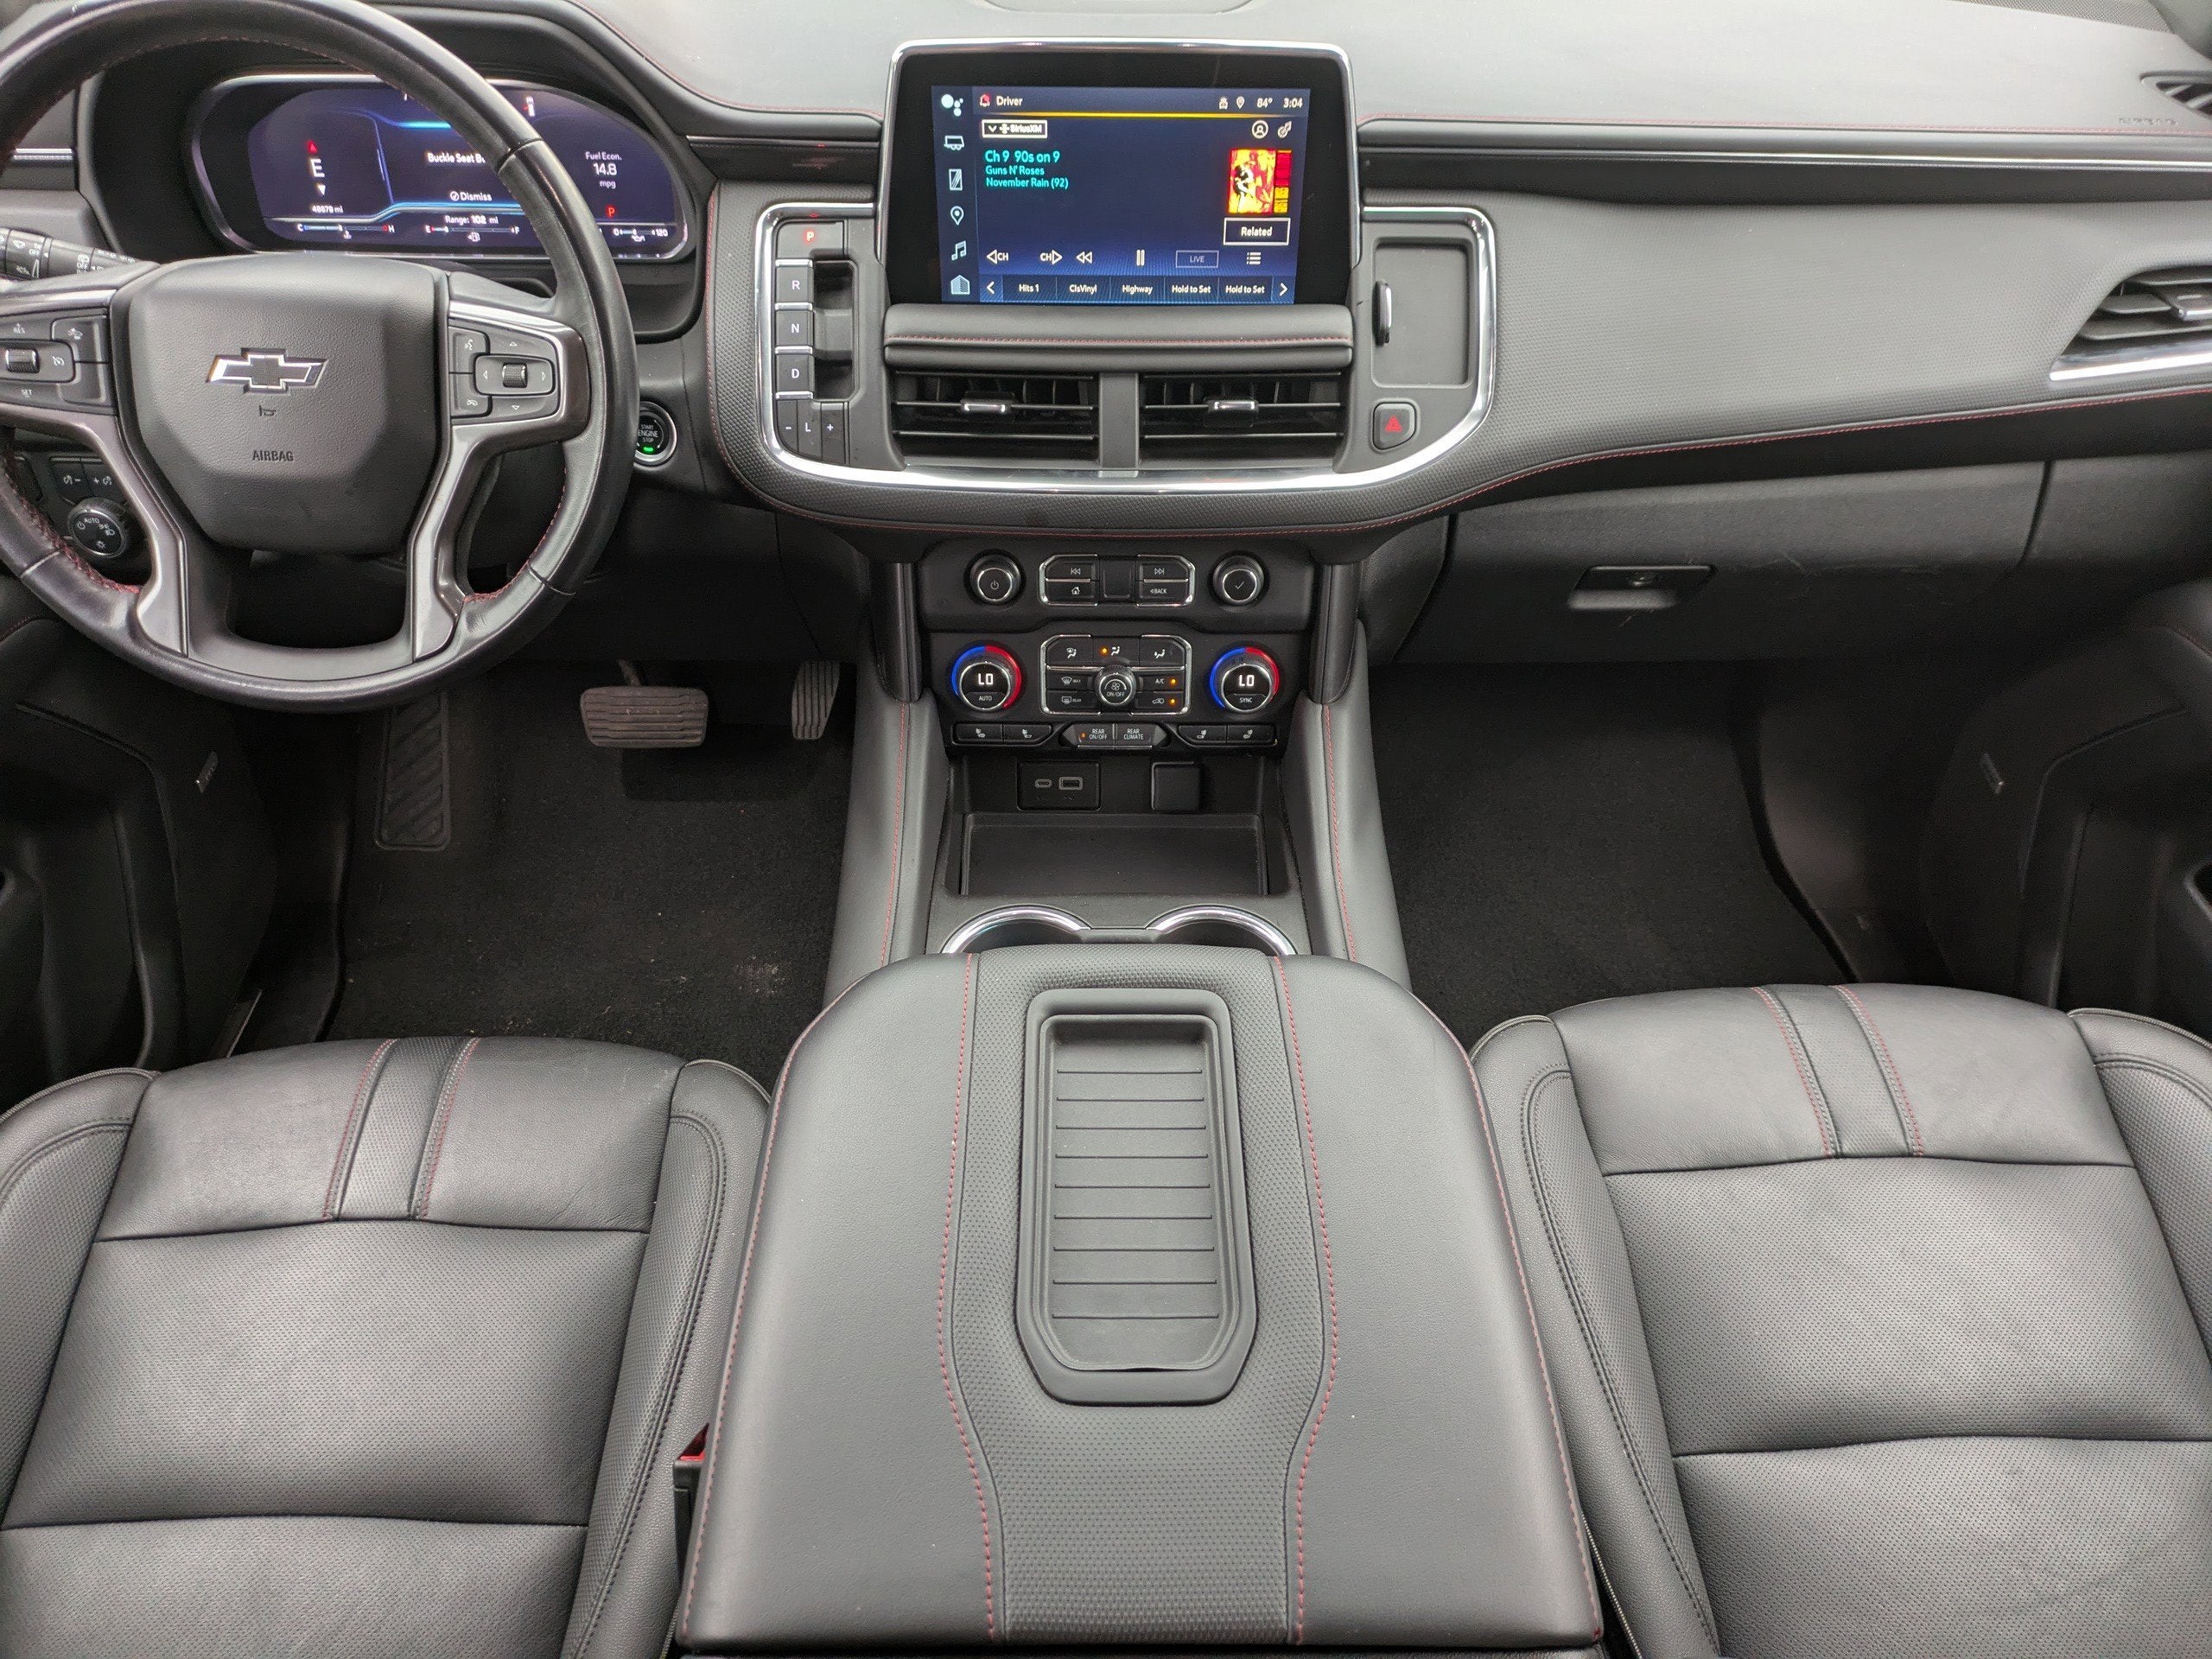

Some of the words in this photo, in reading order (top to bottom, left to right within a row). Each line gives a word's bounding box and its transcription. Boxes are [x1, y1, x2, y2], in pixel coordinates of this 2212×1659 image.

[995, 95, 1023, 106] Driver
[1283, 98, 1303, 108] 3:04
[427, 152, 454, 162] Buckle
[455, 153, 474, 163] Seat
[585, 150, 601, 161] Fuel
[601, 151, 622, 161] Econ.
[984, 149, 1001, 162] Ch
[1002, 149, 1010, 162] 9
[1014, 149, 1035, 162] 90s
[1036, 152, 1051, 163] on
[1052, 150, 1060, 163] 9
[309, 158, 325, 177] E
[593, 162, 618, 176] 14.8
[985, 165, 1007, 175] Guns
[1019, 165, 1045, 175] Roses
[599, 180, 617, 189] mpg
[986, 177, 1029, 188] November
[1030, 177, 1050, 188] Rain
[1051, 177, 1069, 189] (92)
[459, 191, 493, 201] Dismiss
[607, 207, 615, 217] P
[444, 215, 470, 226] Range:
[804, 230, 815, 242] P
[1240, 226, 1273, 237] Related
[997, 252, 1009, 261] CH
[1039, 252, 1052, 262] CH
[1189, 255, 1205, 264] LIVE
[791, 280, 800, 290] R
[1122, 284, 1154, 295] Highway
[1172, 284, 1188, 294] Hold
[1189, 285, 1198, 294] to
[1198, 285, 1211, 294] Set
[1225, 285, 1242, 295] Hold
[1243, 286, 1251, 295] to
[1252, 286, 1265, 295] Set
[791, 323, 800, 334] N
[791, 368, 800, 378] D
[804, 422, 811, 432] L
[252, 449, 294, 461] AIRBAG
